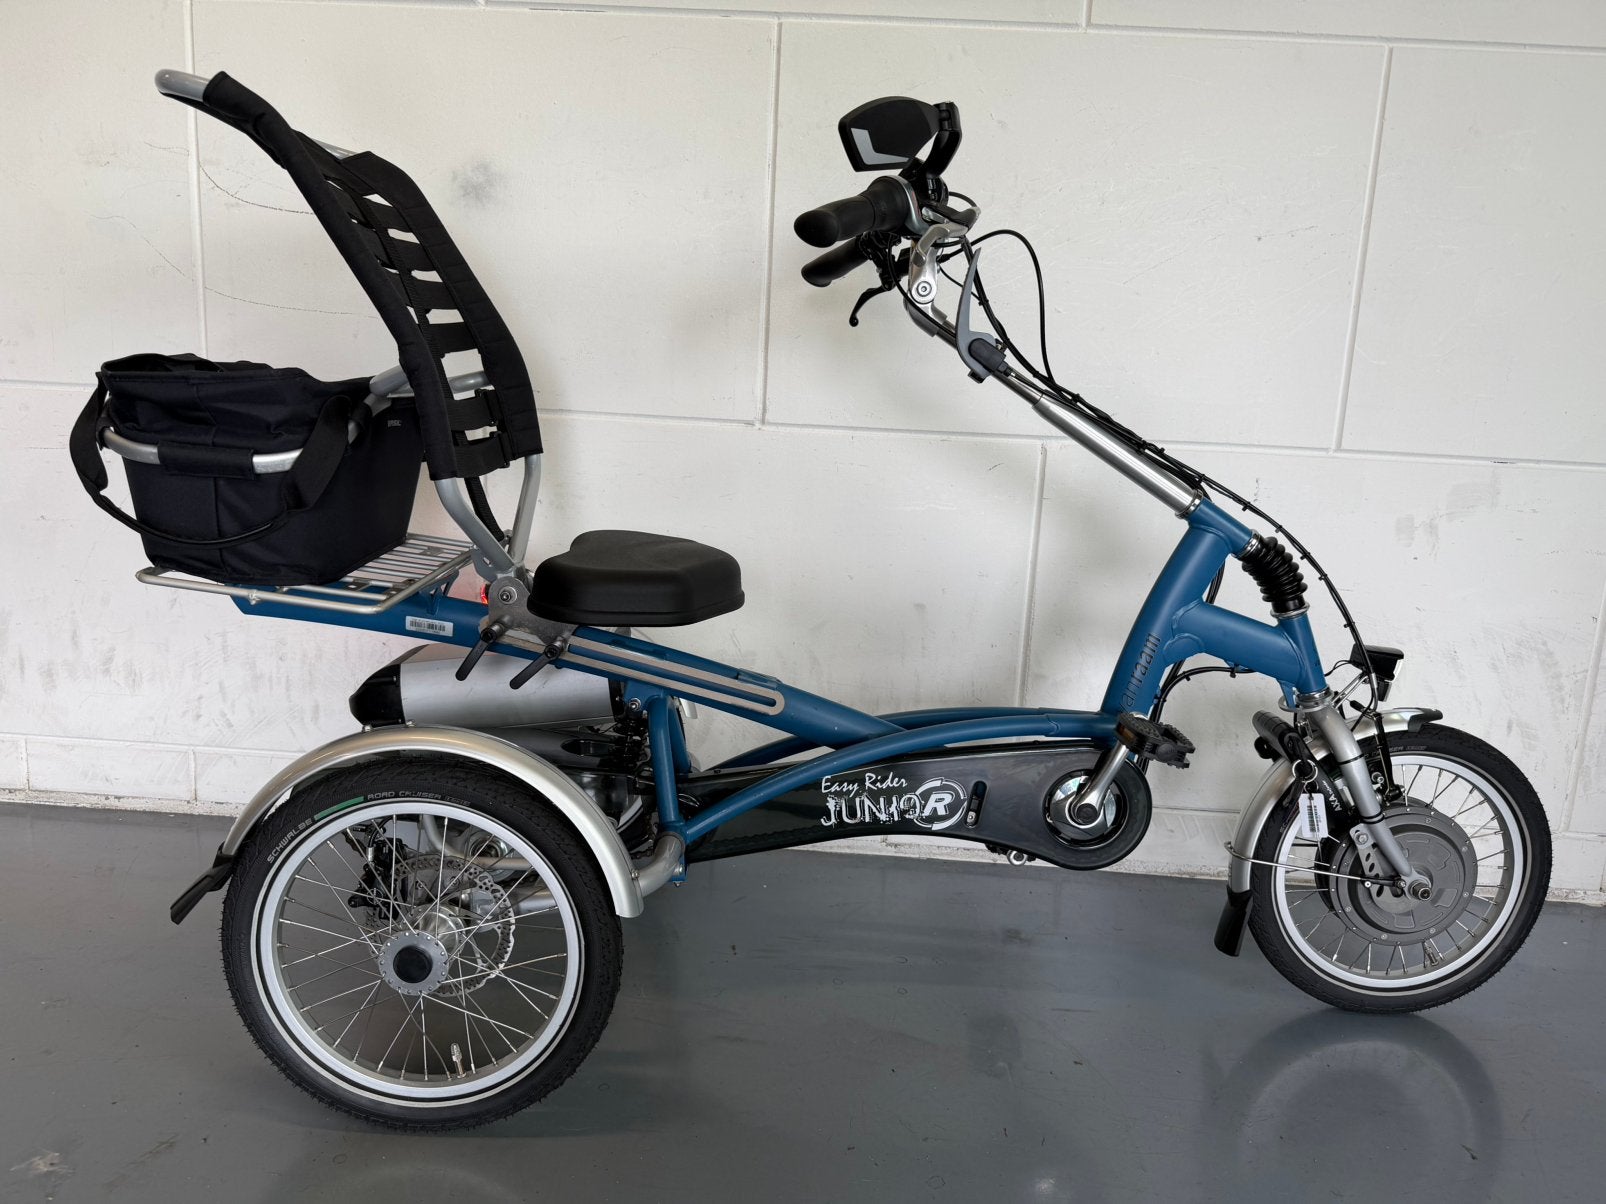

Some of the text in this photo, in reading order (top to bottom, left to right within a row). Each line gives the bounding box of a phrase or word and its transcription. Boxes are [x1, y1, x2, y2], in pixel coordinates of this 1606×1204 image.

[367, 791, 442, 800] ROAD CRUISER
[822, 772, 908, 797] Easy Rider
[820, 792, 956, 828] JUNIOR
[267, 818, 312, 864] SCHWALBE
